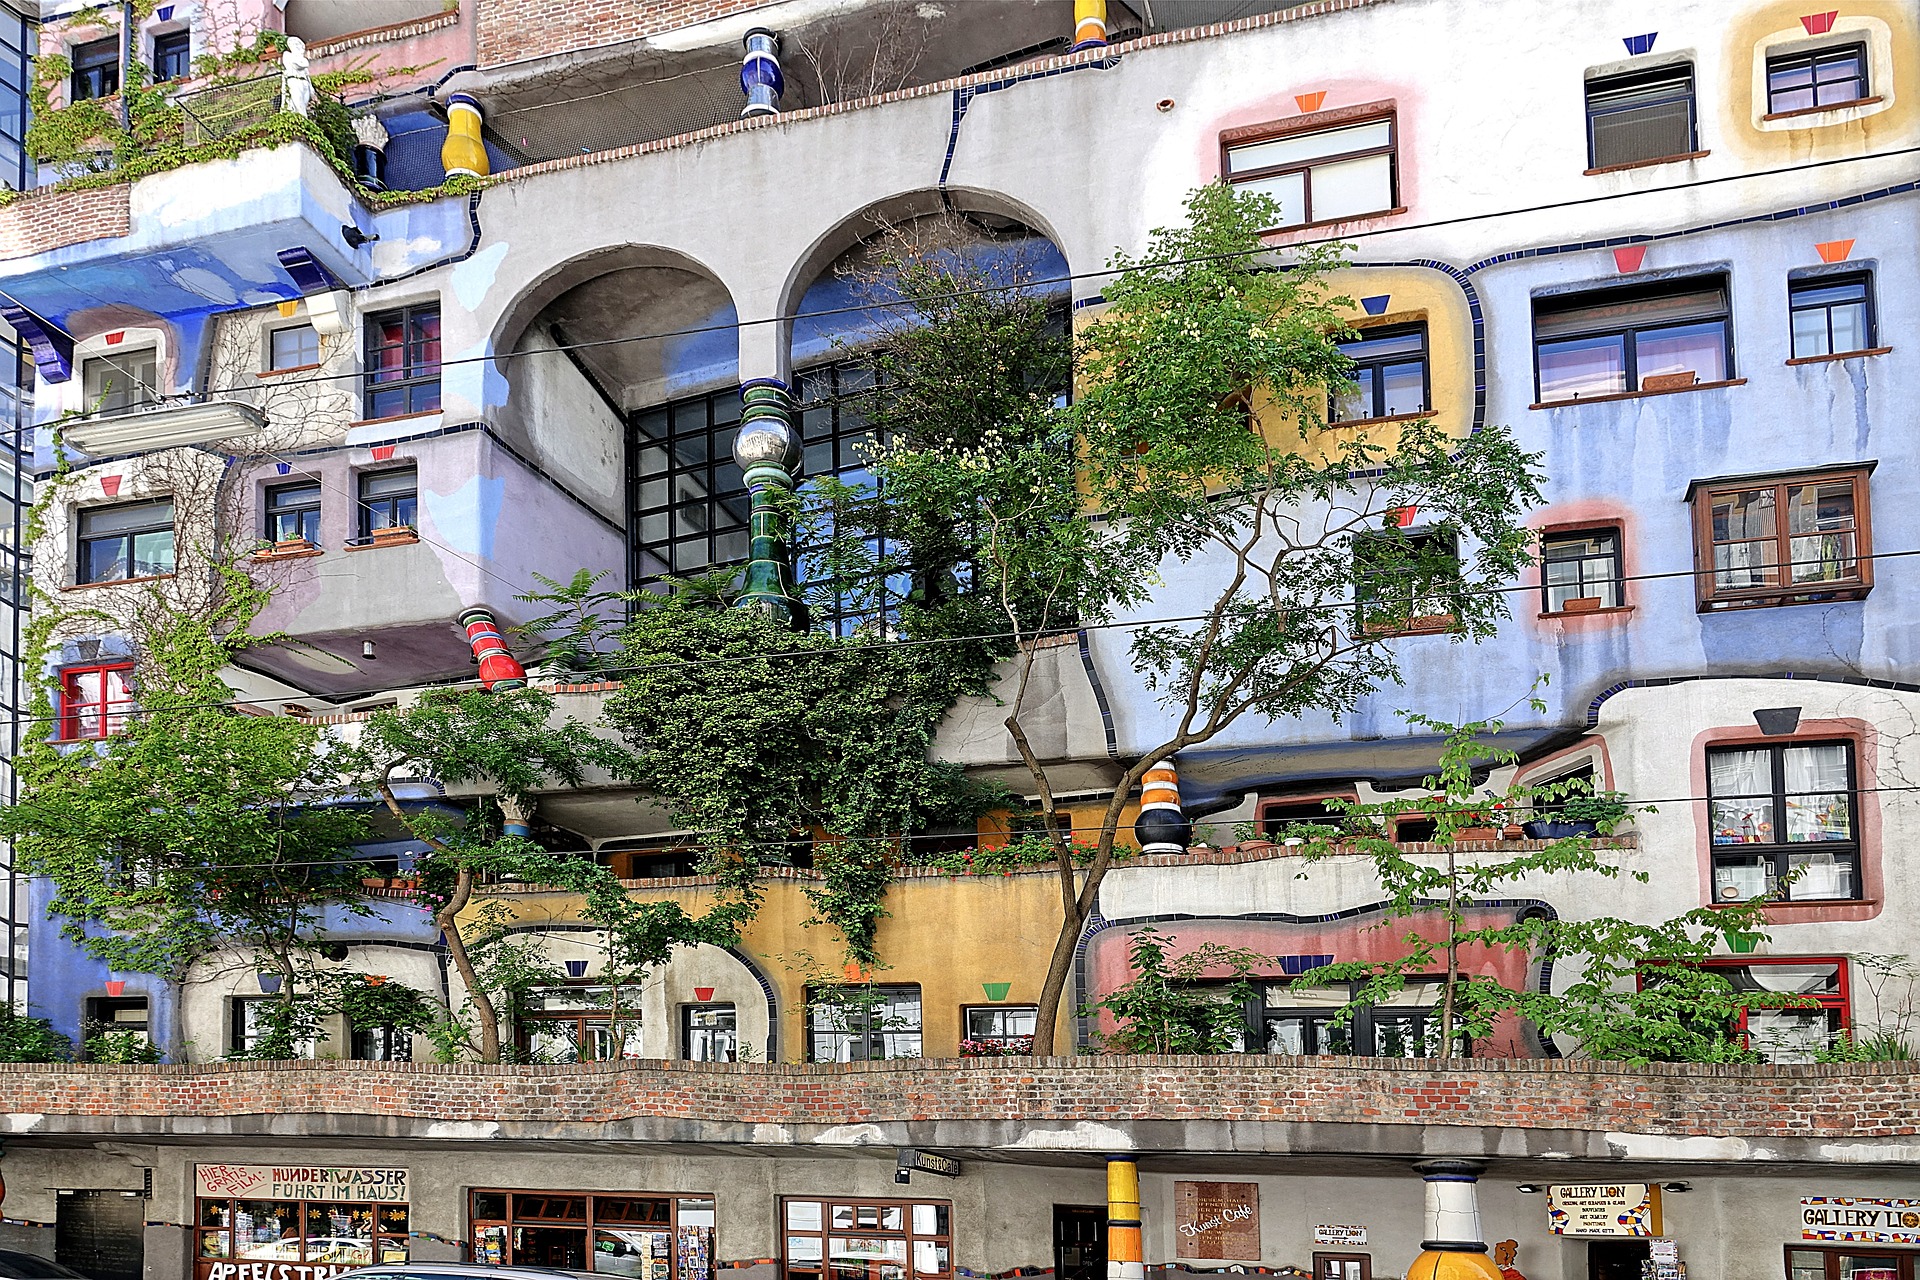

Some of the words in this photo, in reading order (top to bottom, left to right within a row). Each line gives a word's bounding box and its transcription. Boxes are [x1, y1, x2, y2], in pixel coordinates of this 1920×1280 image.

[272, 1168, 407, 1185] HUNDERTWASSER
[272, 1183, 325, 1199] FÜHRT
[332, 1185, 350, 1199] IM
[357, 1186, 406, 1200] HAUS!
[1560, 1186, 1598, 1198] GALLERY
[1600, 1186, 1626, 1198] LION
[1179, 1215, 1223, 1237] Kunst
[1222, 1204, 1253, 1222] Café
[1803, 1208, 1881, 1227] GALLERY
[1884, 1210, 1920, 1229] LIO
